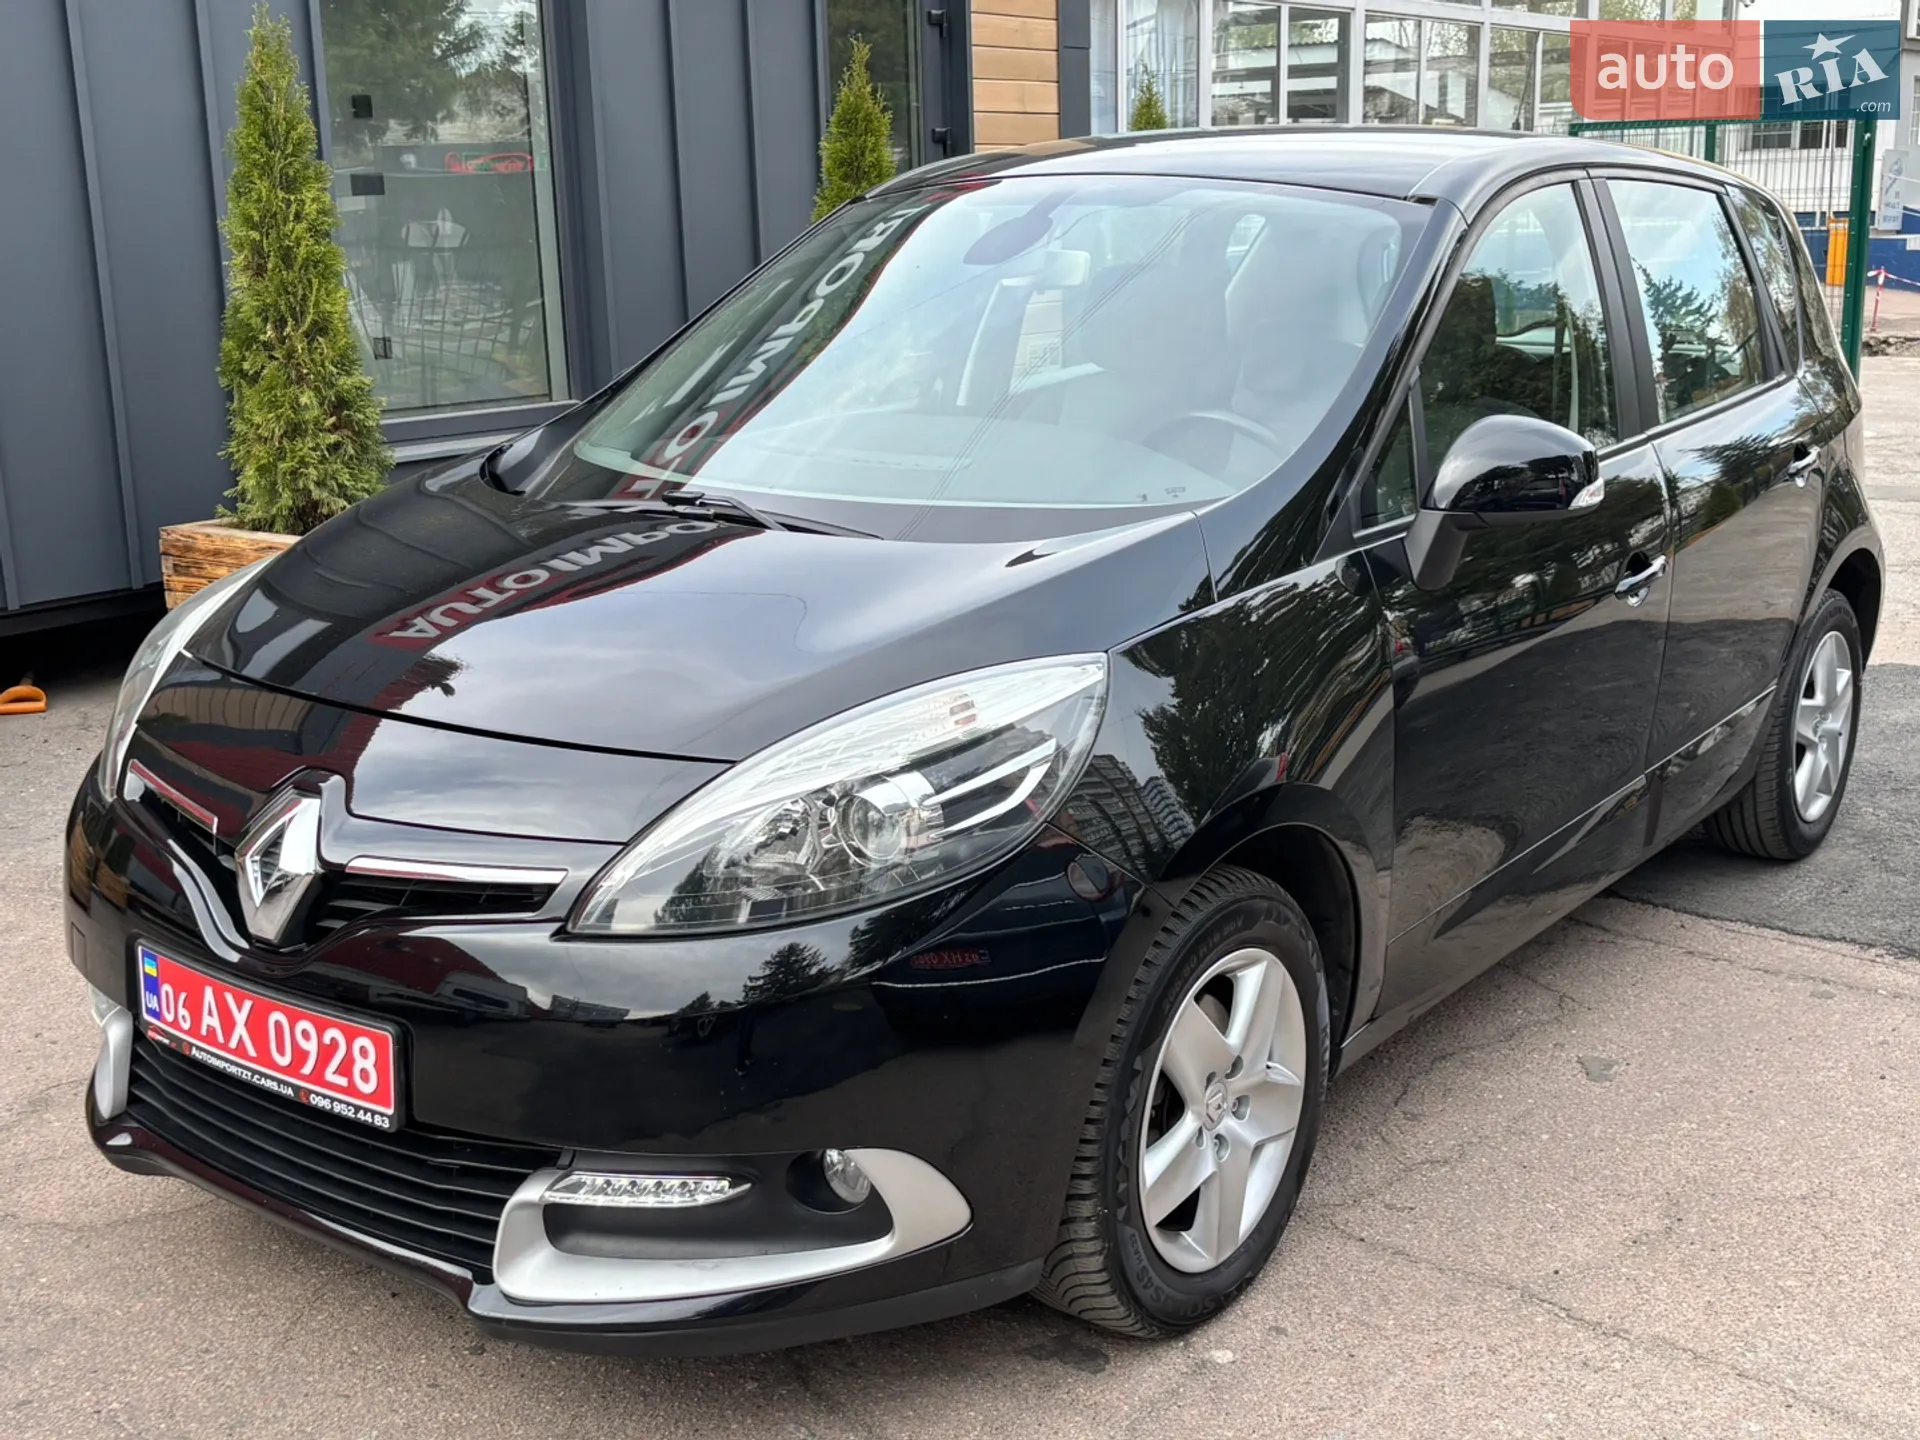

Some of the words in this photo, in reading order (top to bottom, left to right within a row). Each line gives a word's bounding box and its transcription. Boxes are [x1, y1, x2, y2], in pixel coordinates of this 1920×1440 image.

[145, 990, 160, 1012] UA
[160, 982, 191, 1031] 06
[200, 985, 258, 1058] AX
[267, 1010, 378, 1095] 0928
[309, 1093, 332, 1110] 096
[333, 1101, 356, 1118] 952
[357, 1109, 373, 1123] 44
[374, 1114, 390, 1128] 83
